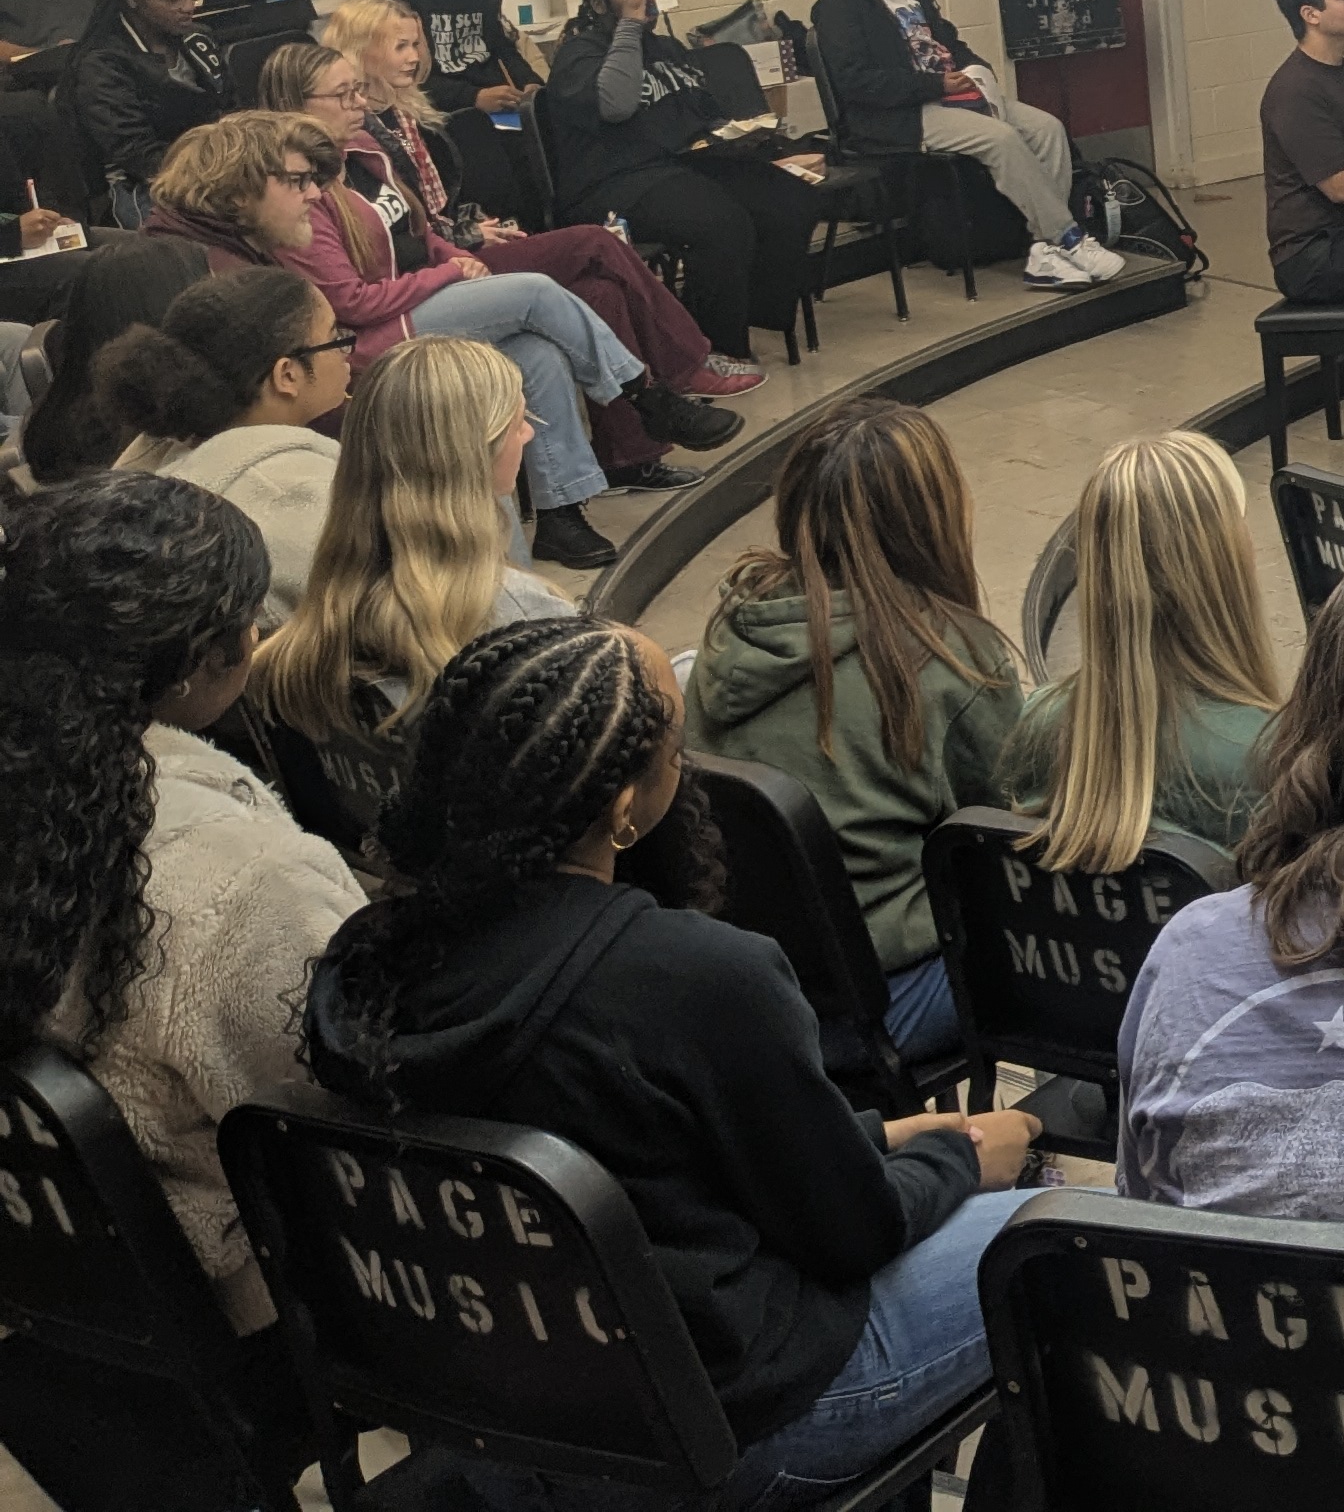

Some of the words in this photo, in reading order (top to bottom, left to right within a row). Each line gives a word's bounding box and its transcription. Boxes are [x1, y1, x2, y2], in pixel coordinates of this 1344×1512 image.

[318, 750, 400, 796] MUSI
[1002, 854, 1172, 925] PAGE
[1003, 928, 1128, 994] MUS
[325, 1146, 554, 1248] PAGE
[338, 1234, 610, 1345] MUSIC
